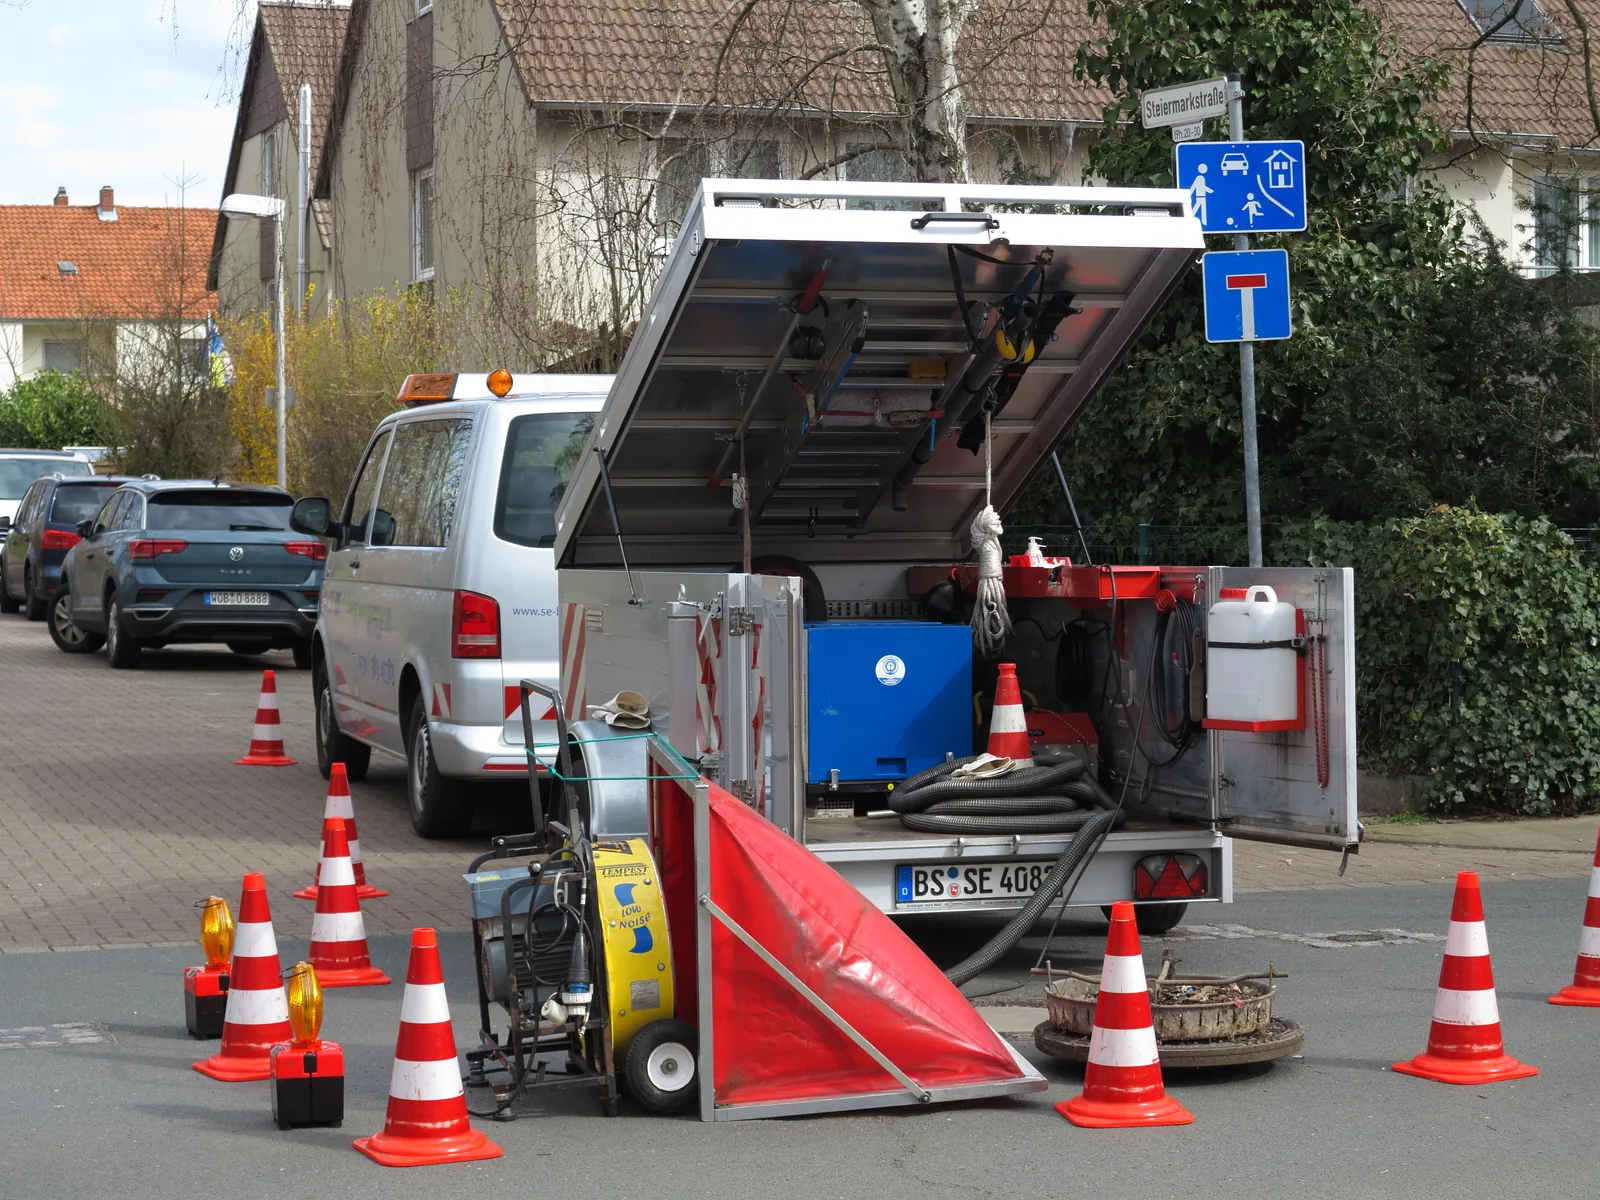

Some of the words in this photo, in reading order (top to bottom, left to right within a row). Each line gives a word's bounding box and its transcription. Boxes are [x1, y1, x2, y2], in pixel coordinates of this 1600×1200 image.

[1146, 87, 1224, 118] Steiermarkstraße
[211, 592, 229, 603] WOB
[244, 592, 267, 603] 8888
[598, 866, 649, 876] TEMPEST
[902, 888, 908, 896] D
[915, 870, 944, 897] BS
[964, 867, 993, 895] SE
[621, 905, 642, 918] LOW
